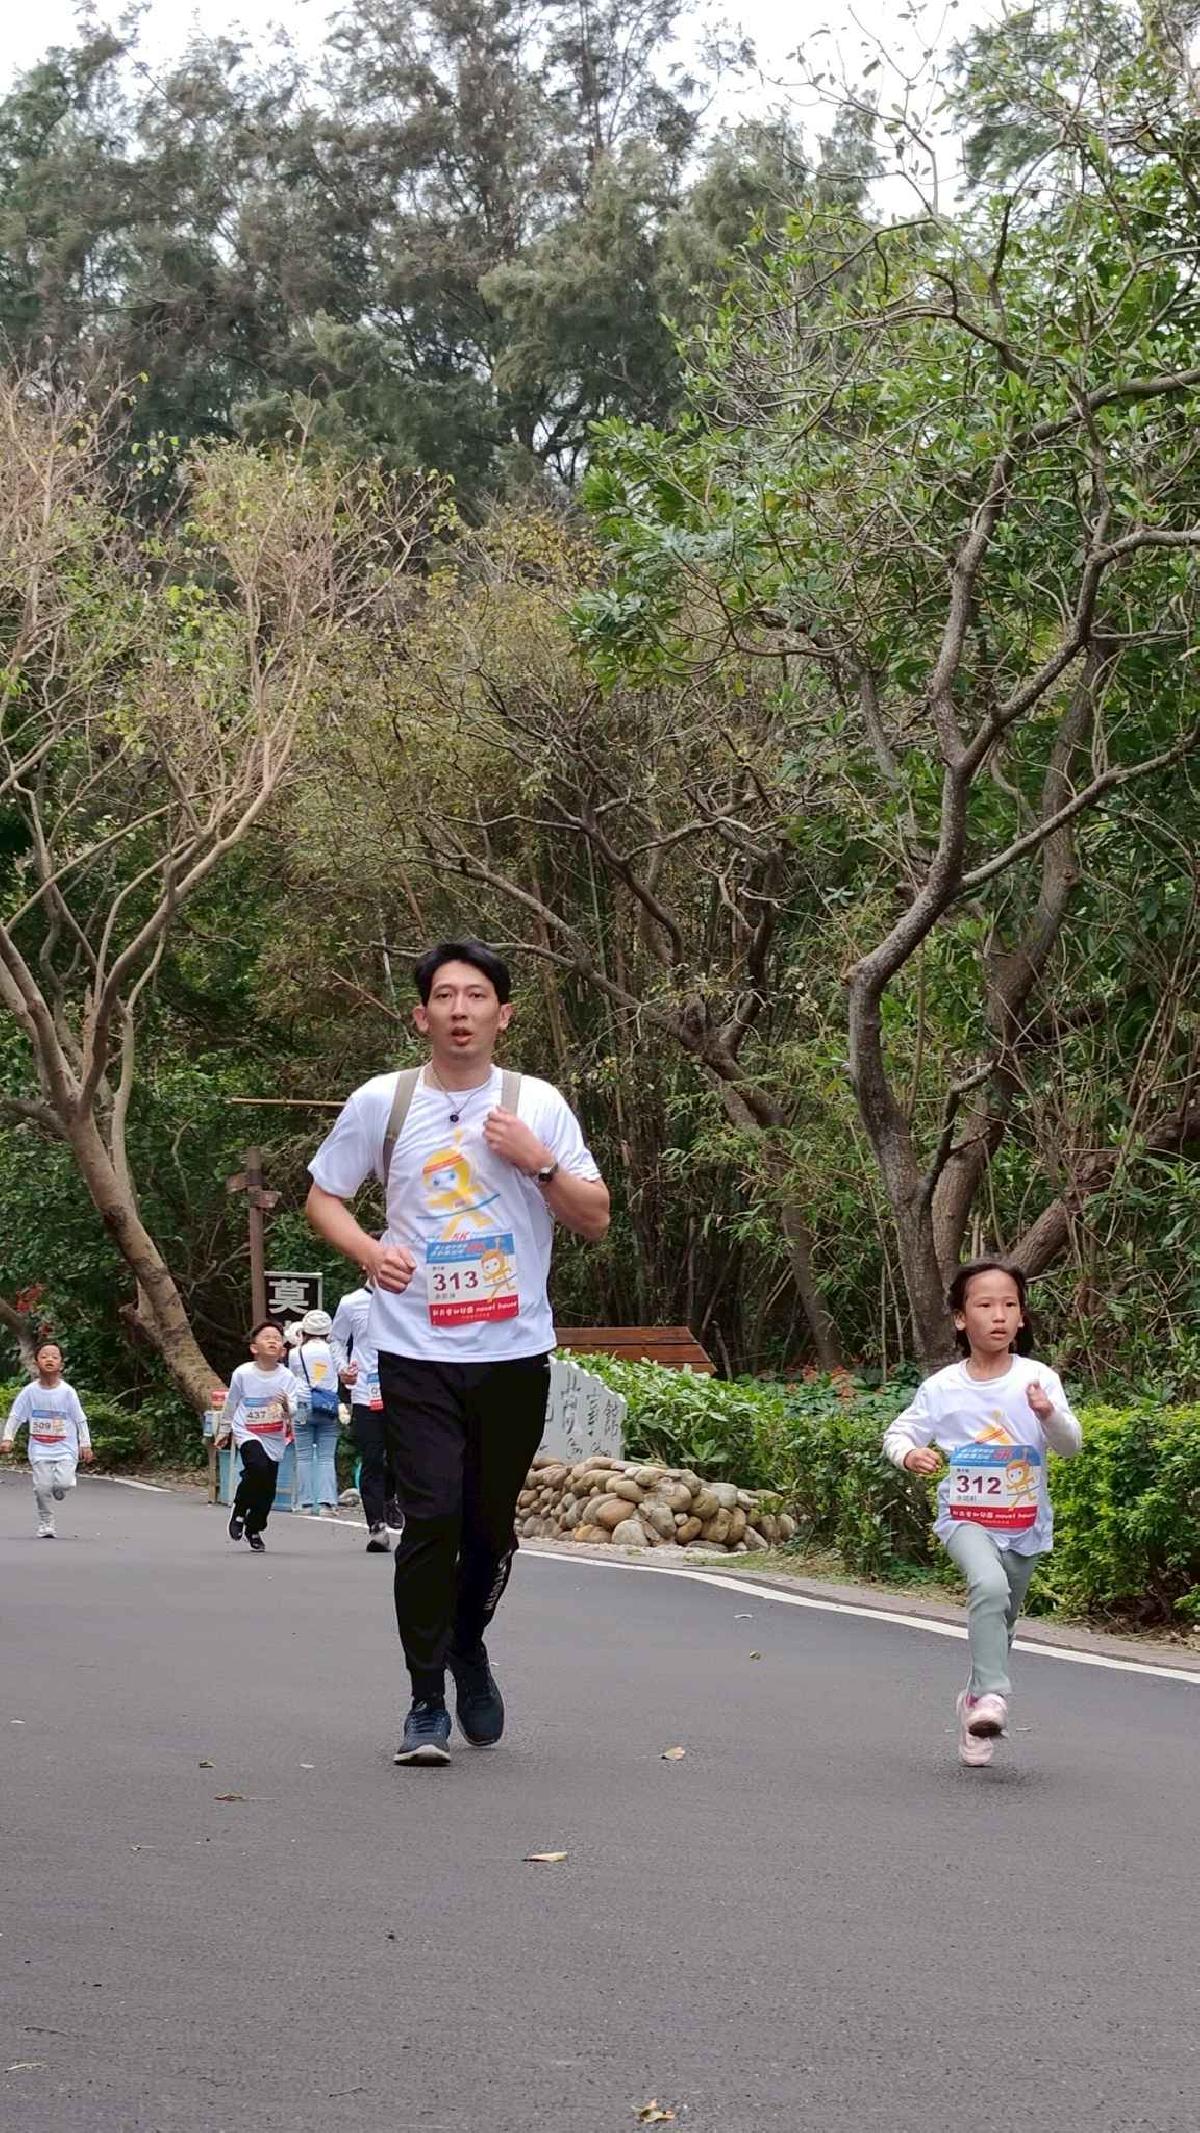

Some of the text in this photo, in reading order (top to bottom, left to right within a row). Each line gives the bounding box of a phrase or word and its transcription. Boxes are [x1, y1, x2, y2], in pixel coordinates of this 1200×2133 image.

[432, 1271, 479, 1291] 313
[268, 1279, 310, 1314] 莫
[956, 1475, 1002, 1494] 312
